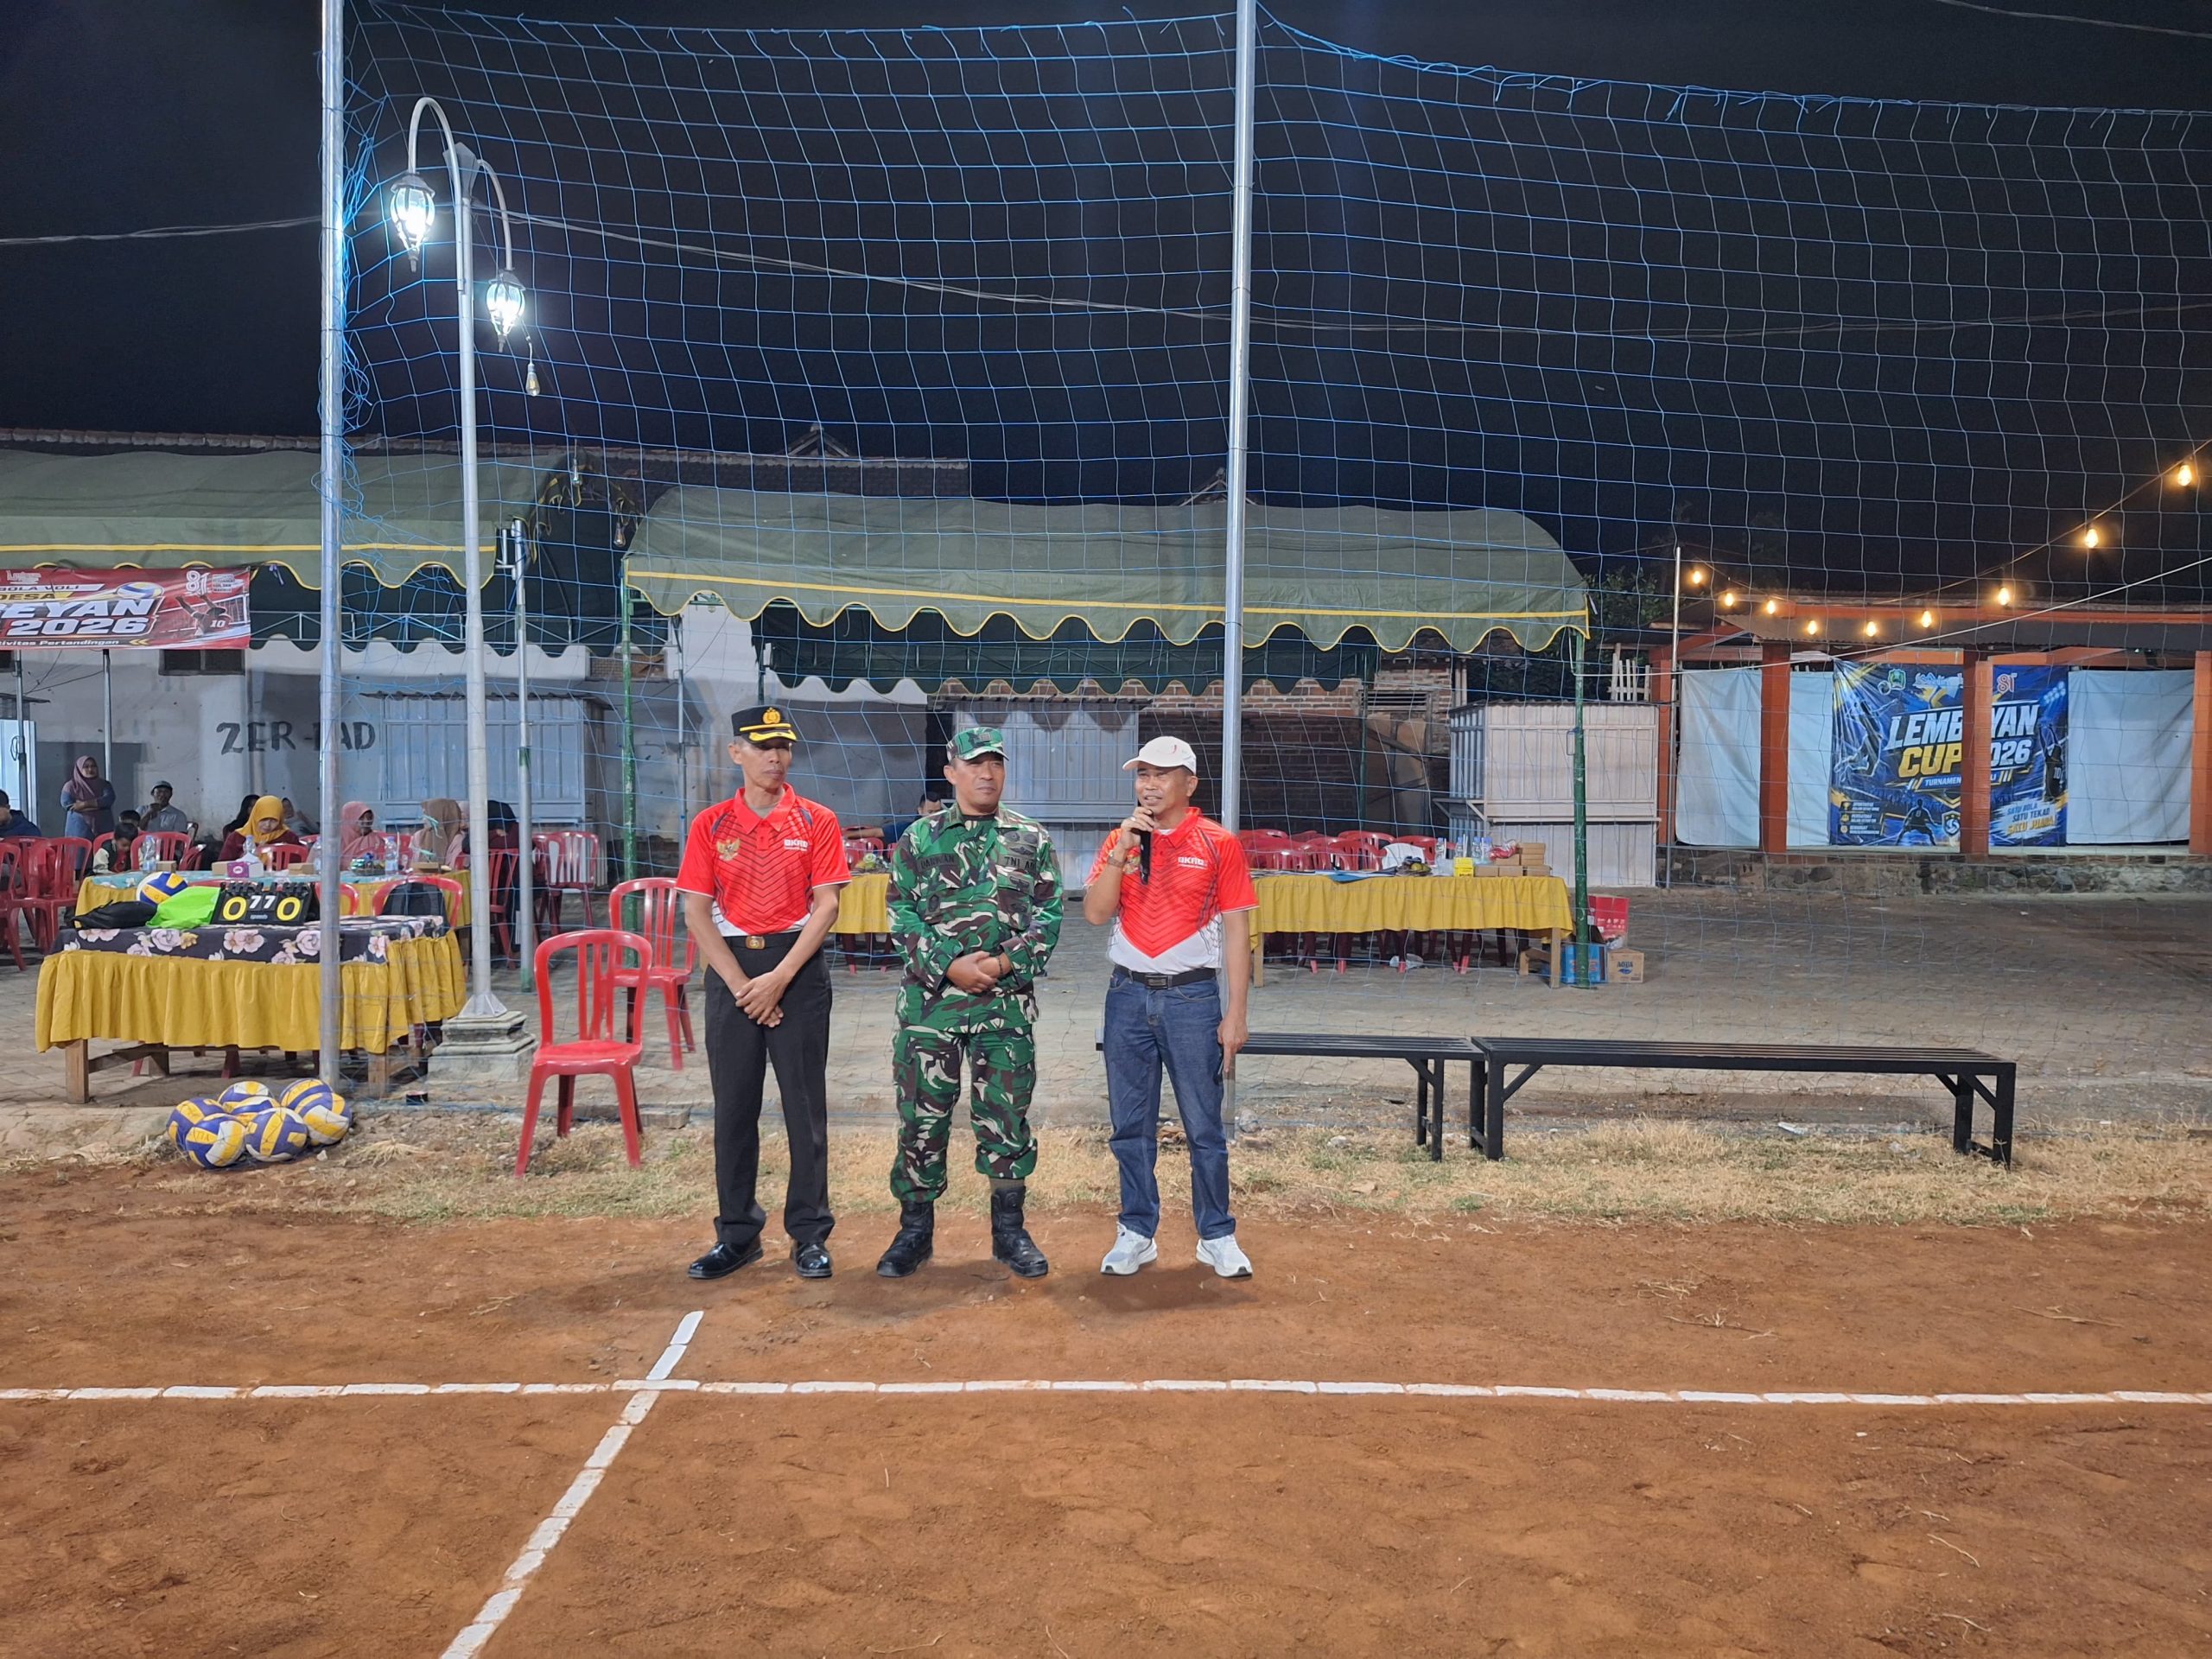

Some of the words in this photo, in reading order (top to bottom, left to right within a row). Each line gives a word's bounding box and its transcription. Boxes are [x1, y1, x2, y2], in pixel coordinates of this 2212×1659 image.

[0, 599, 154, 619] EYAN
[7, 617, 148, 636] 2026
[210, 620, 226, 628] 10
[1882, 704, 2040, 751] LEMBYAN
[1898, 742, 1962, 778] CUP
[1991, 740, 2032, 767] 026
[1004, 856, 1020, 869] TNI
[222, 896, 247, 922] 0
[276, 896, 302, 922] 0
